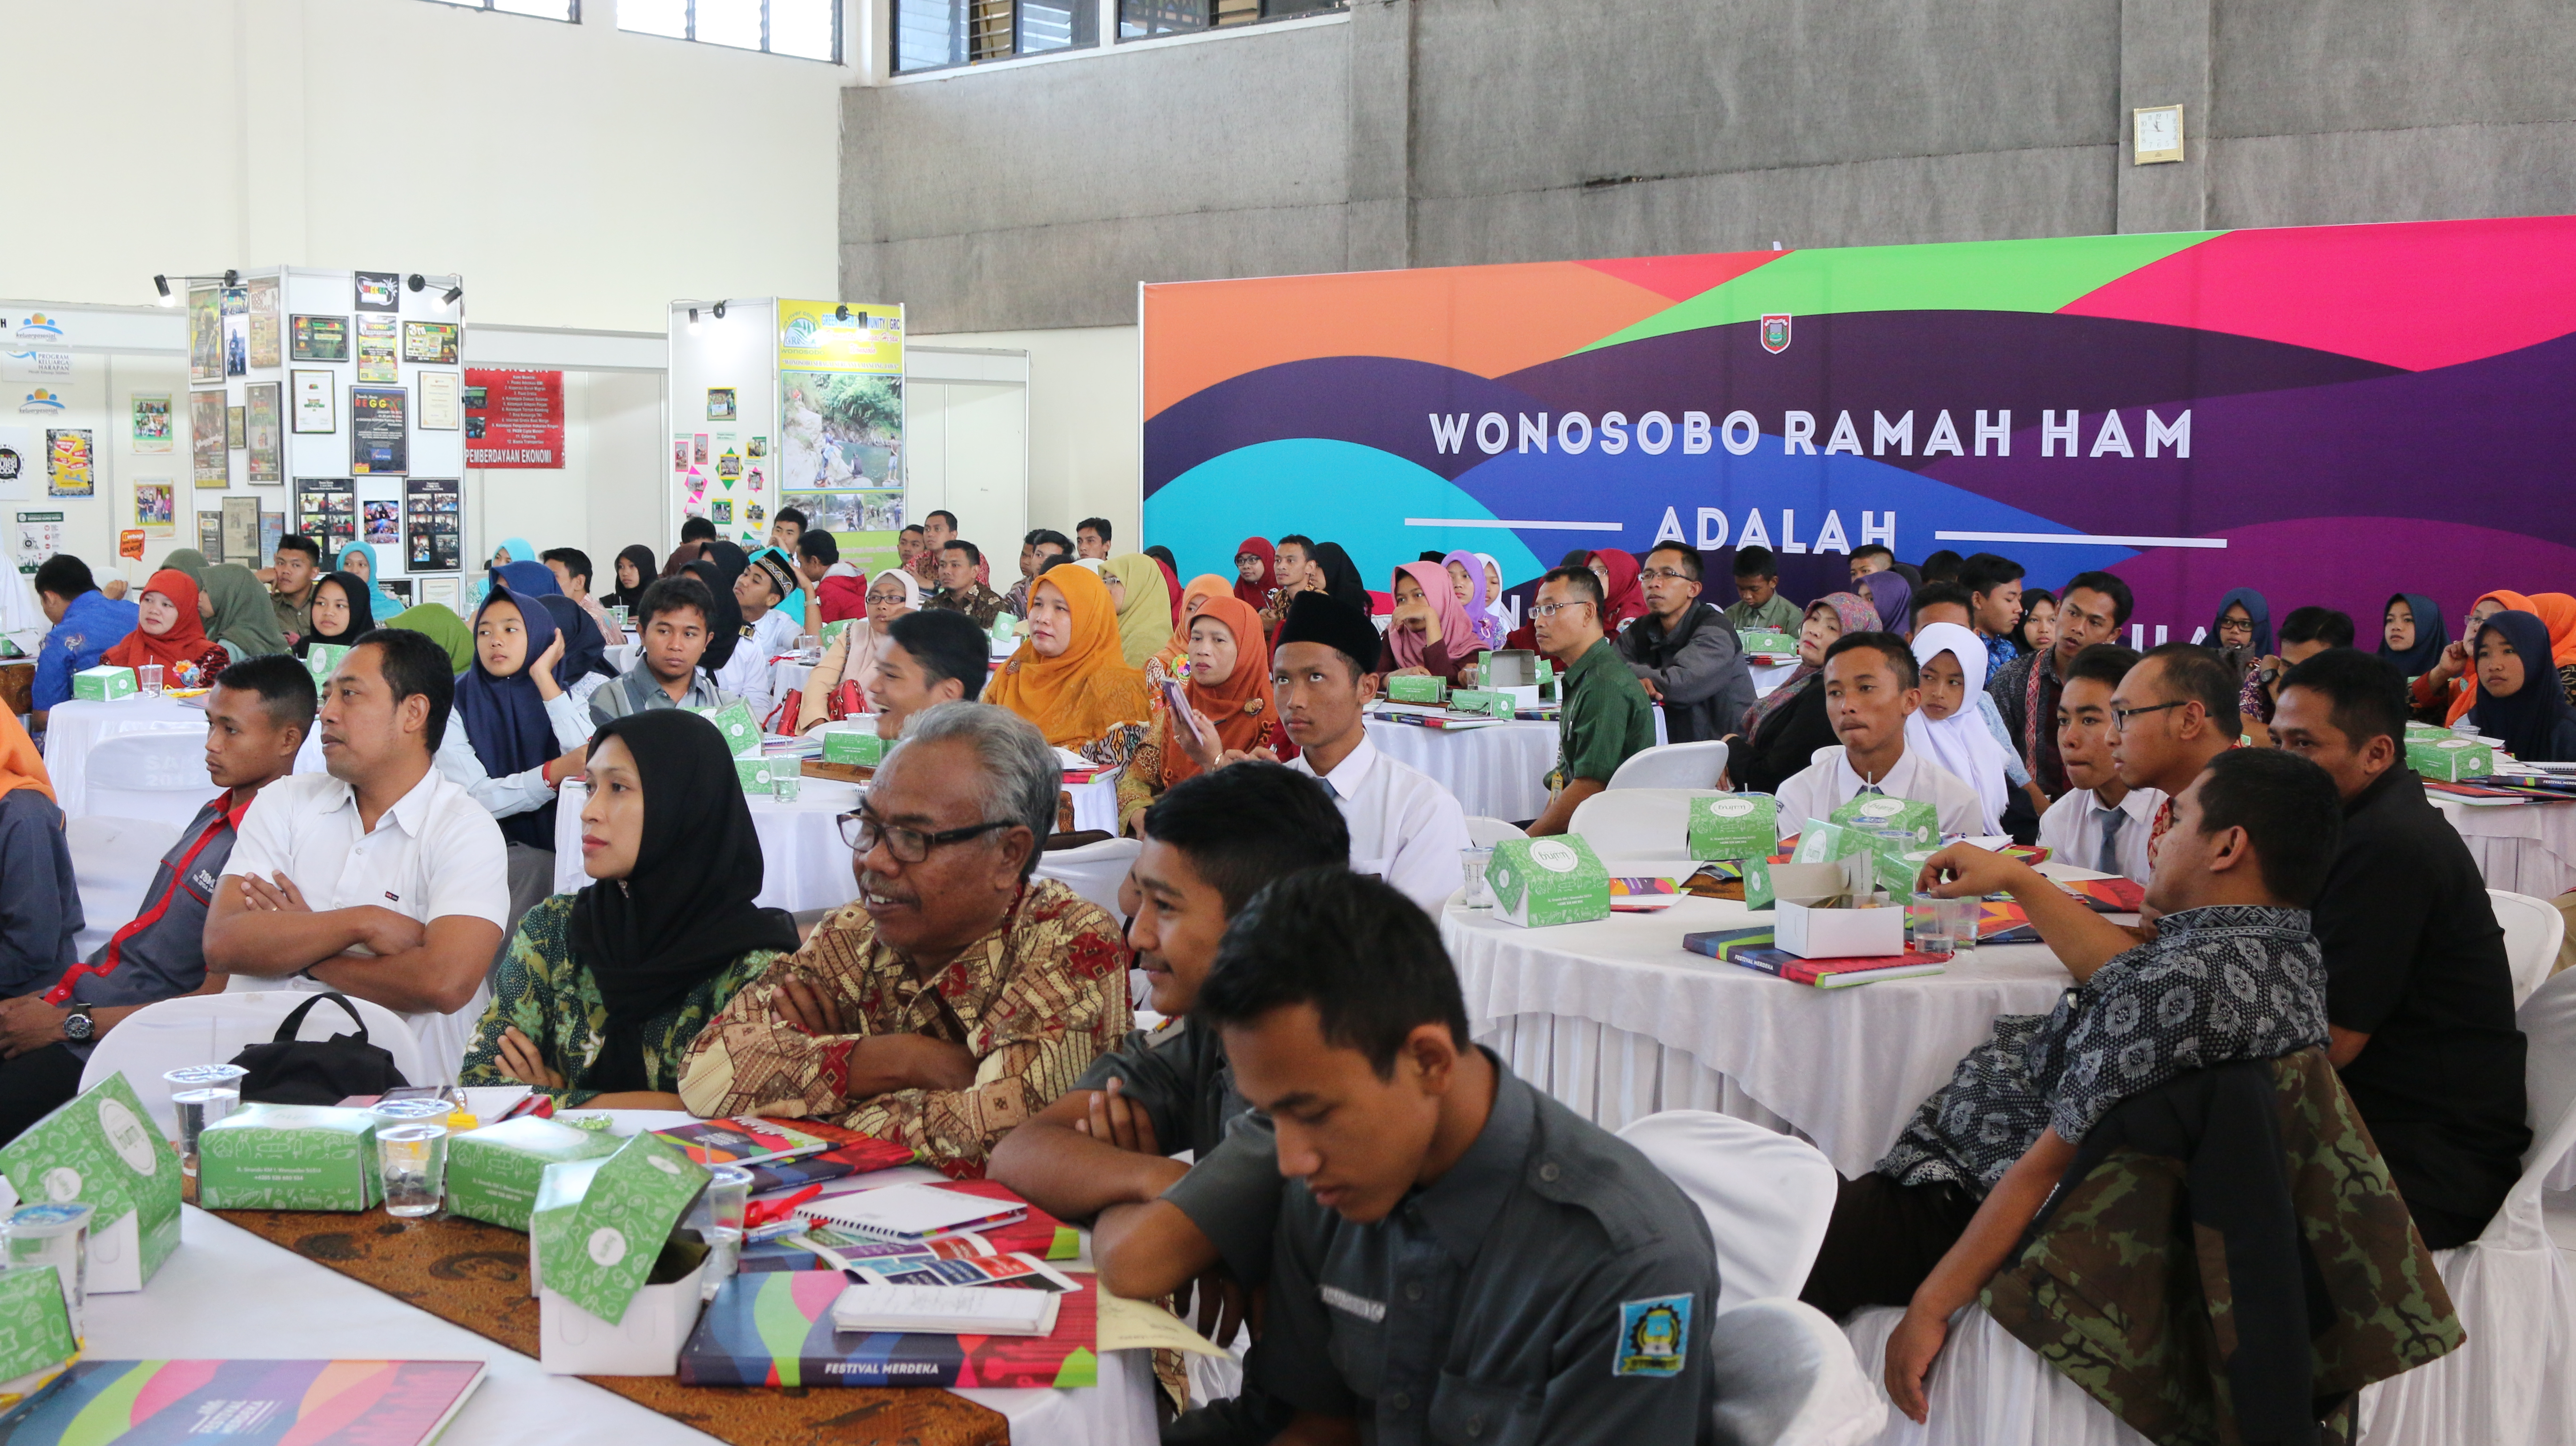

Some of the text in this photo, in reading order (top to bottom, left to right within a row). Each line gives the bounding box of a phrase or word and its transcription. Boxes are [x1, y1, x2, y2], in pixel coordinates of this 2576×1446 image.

[1429, 409, 2191, 458] WONOSOBO RAMAH HAM
[466, 449, 552, 463] PEMBERDAYAAN EKONOMI
[0, 461, 17, 469] URSI
[1652, 506, 1895, 555] ADALAH
[1734, 954, 1773, 970] FESTIVAL MERDEKA
[825, 1363, 939, 1374] FESTIVAL MERDEKA
